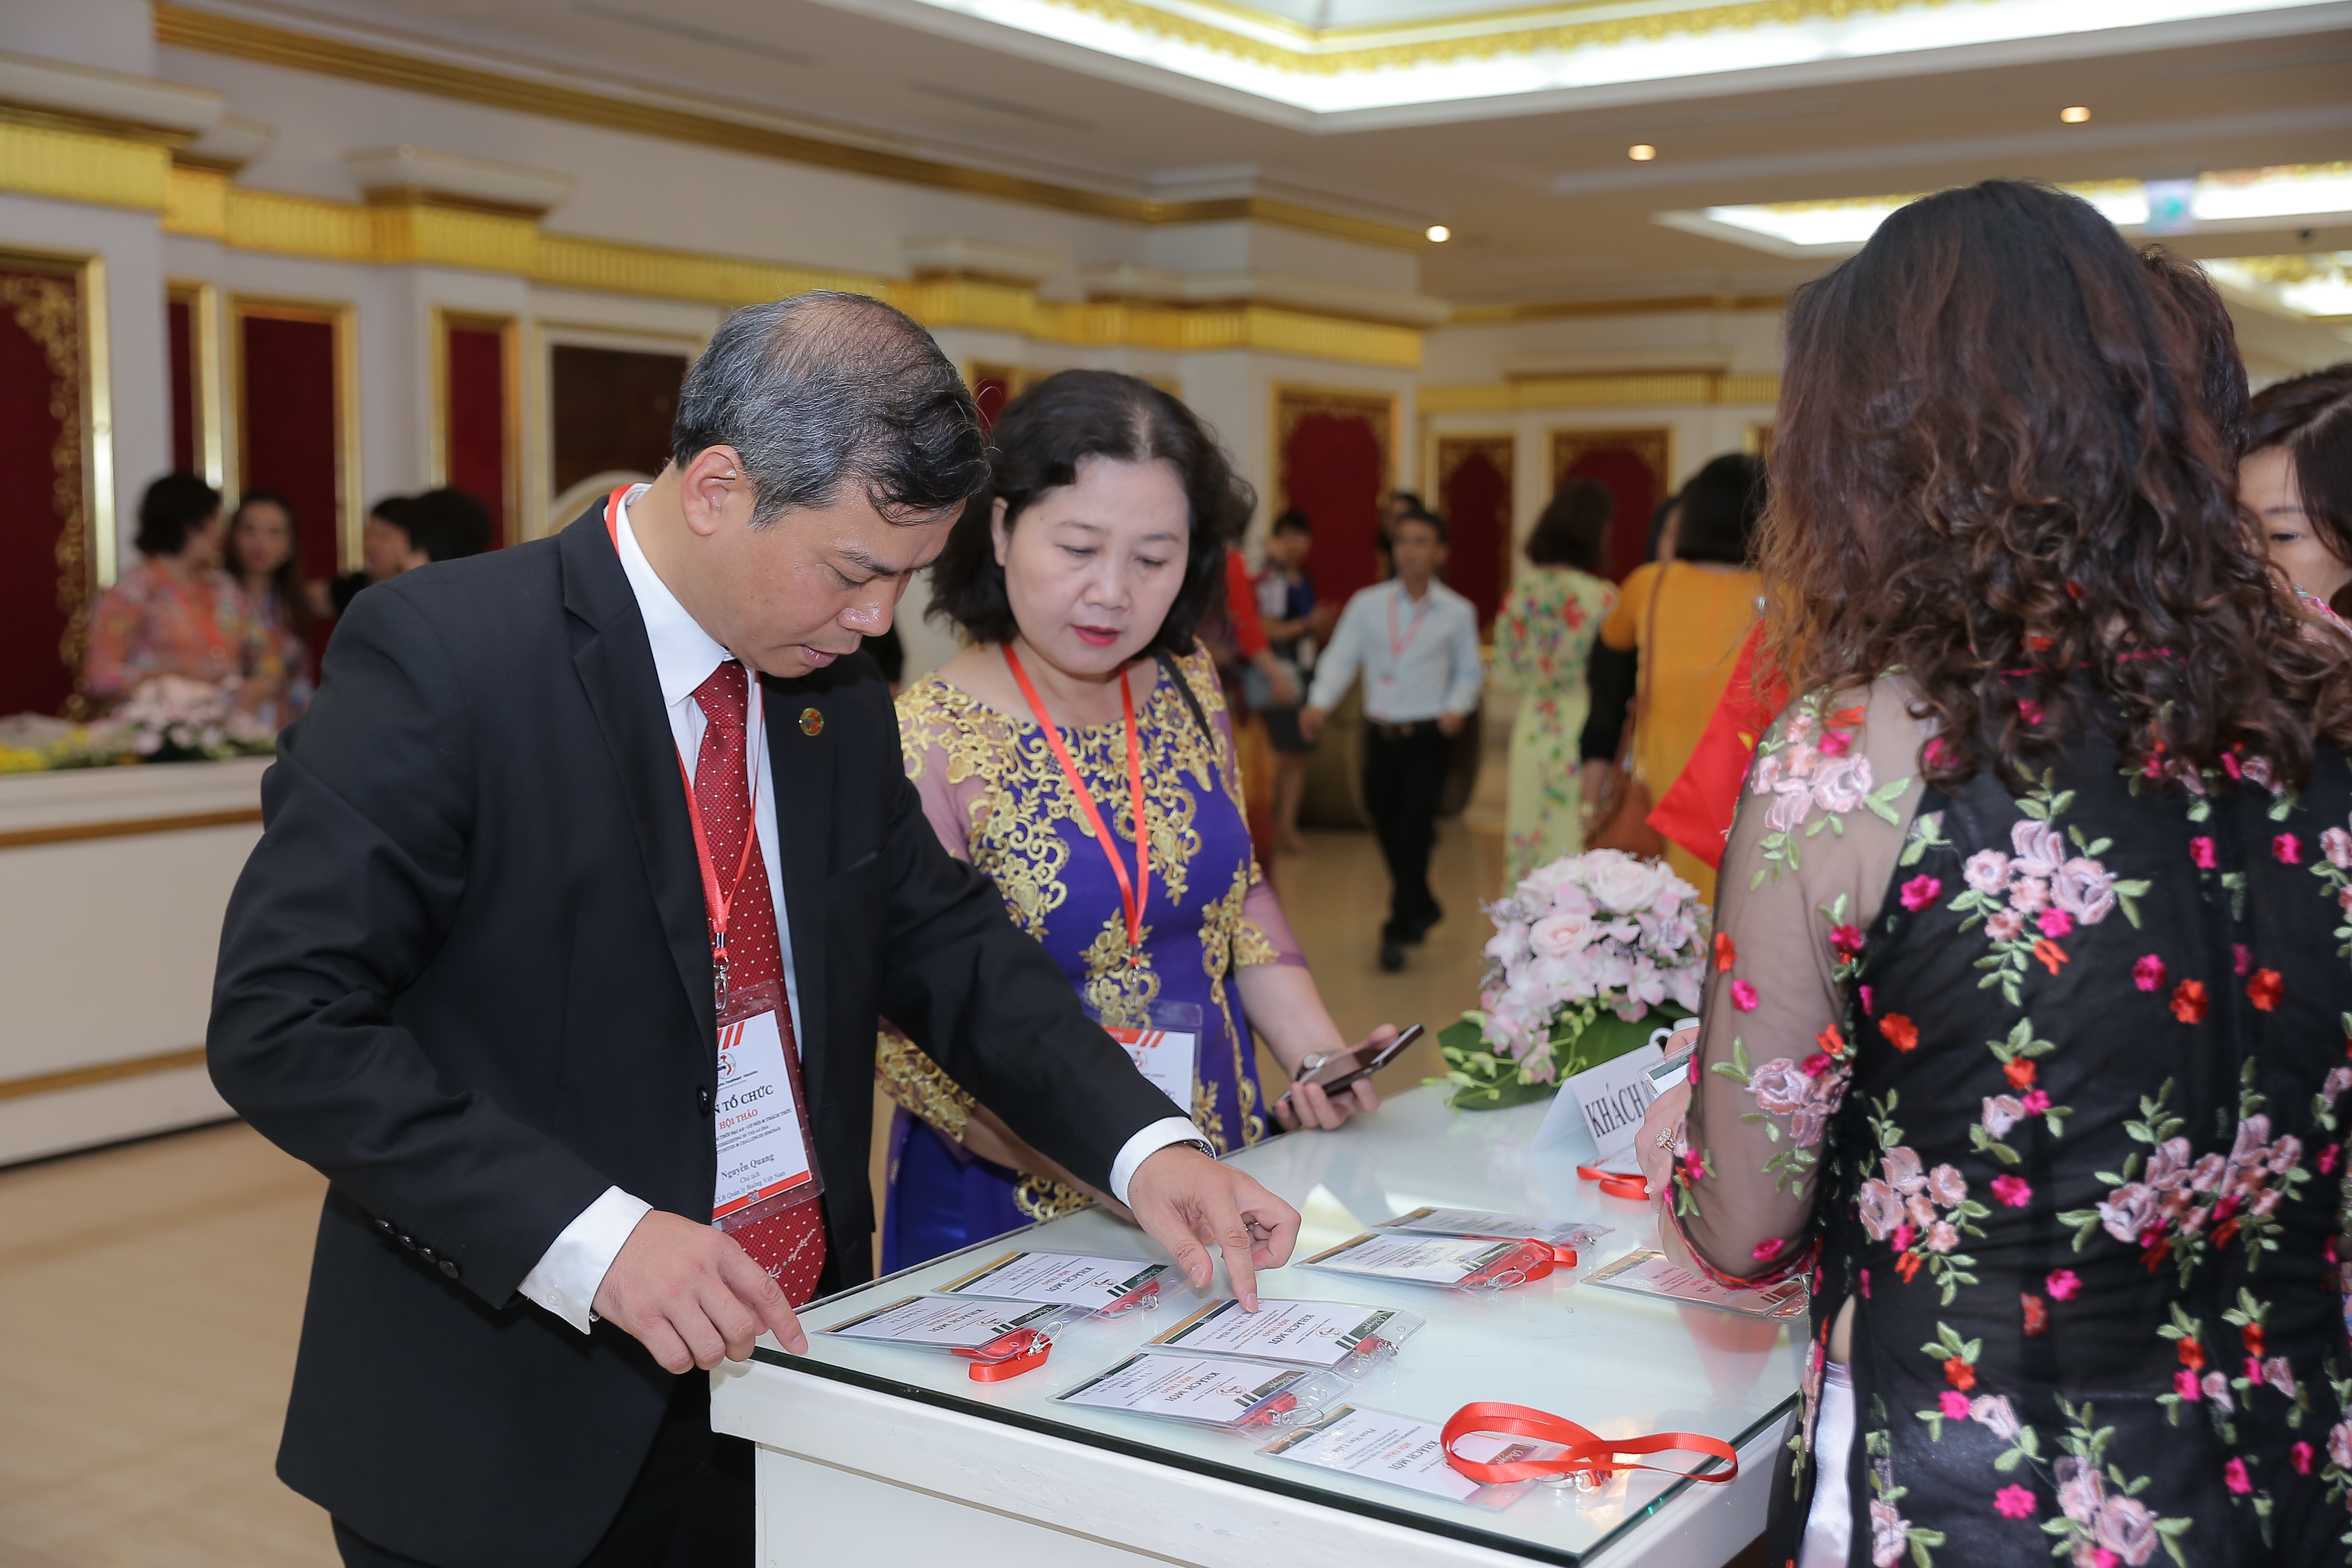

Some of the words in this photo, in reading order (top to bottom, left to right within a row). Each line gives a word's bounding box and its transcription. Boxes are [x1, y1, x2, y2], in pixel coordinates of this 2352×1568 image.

[723, 1094, 738, 1111] TỔ
[741, 1085, 774, 1104] CHỨC
[1586, 1082, 1645, 1137] KHÁCH
[719, 1118, 734, 1130] HỘI
[736, 1109, 758, 1123] THẢO
[721, 1162, 749, 1180] Nguyễn
[750, 1154, 775, 1168] Quang
[714, 1194, 726, 1203] CLB
[1062, 1267, 1095, 1283] KHÁCH
[1044, 1283, 1067, 1292] MỜI
[947, 1309, 986, 1323] KHÁCH
[927, 1323, 952, 1332] MỜI
[1283, 1314, 1315, 1332] KHÁCH
[1362, 1314, 1387, 1332] Delegate
[1262, 1326, 1280, 1336] THẢO
[1268, 1333, 1289, 1344] MỜI
[1119, 1378, 1142, 1387] Thanh
[1183, 1372, 1221, 1390] KHÁCH
[1268, 1375, 1296, 1389] Delegate
[1161, 1384, 1182, 1393] THẢO
[1164, 1390, 1188, 1401] MỜI
[1358, 1428, 1377, 1436] Phan
[1331, 1444, 1351, 1452] Tuấn
[1381, 1449, 1402, 1459] THẢO
[1405, 1440, 1442, 1459] KHÁCH
[1387, 1458, 1412, 1470] MỜI
